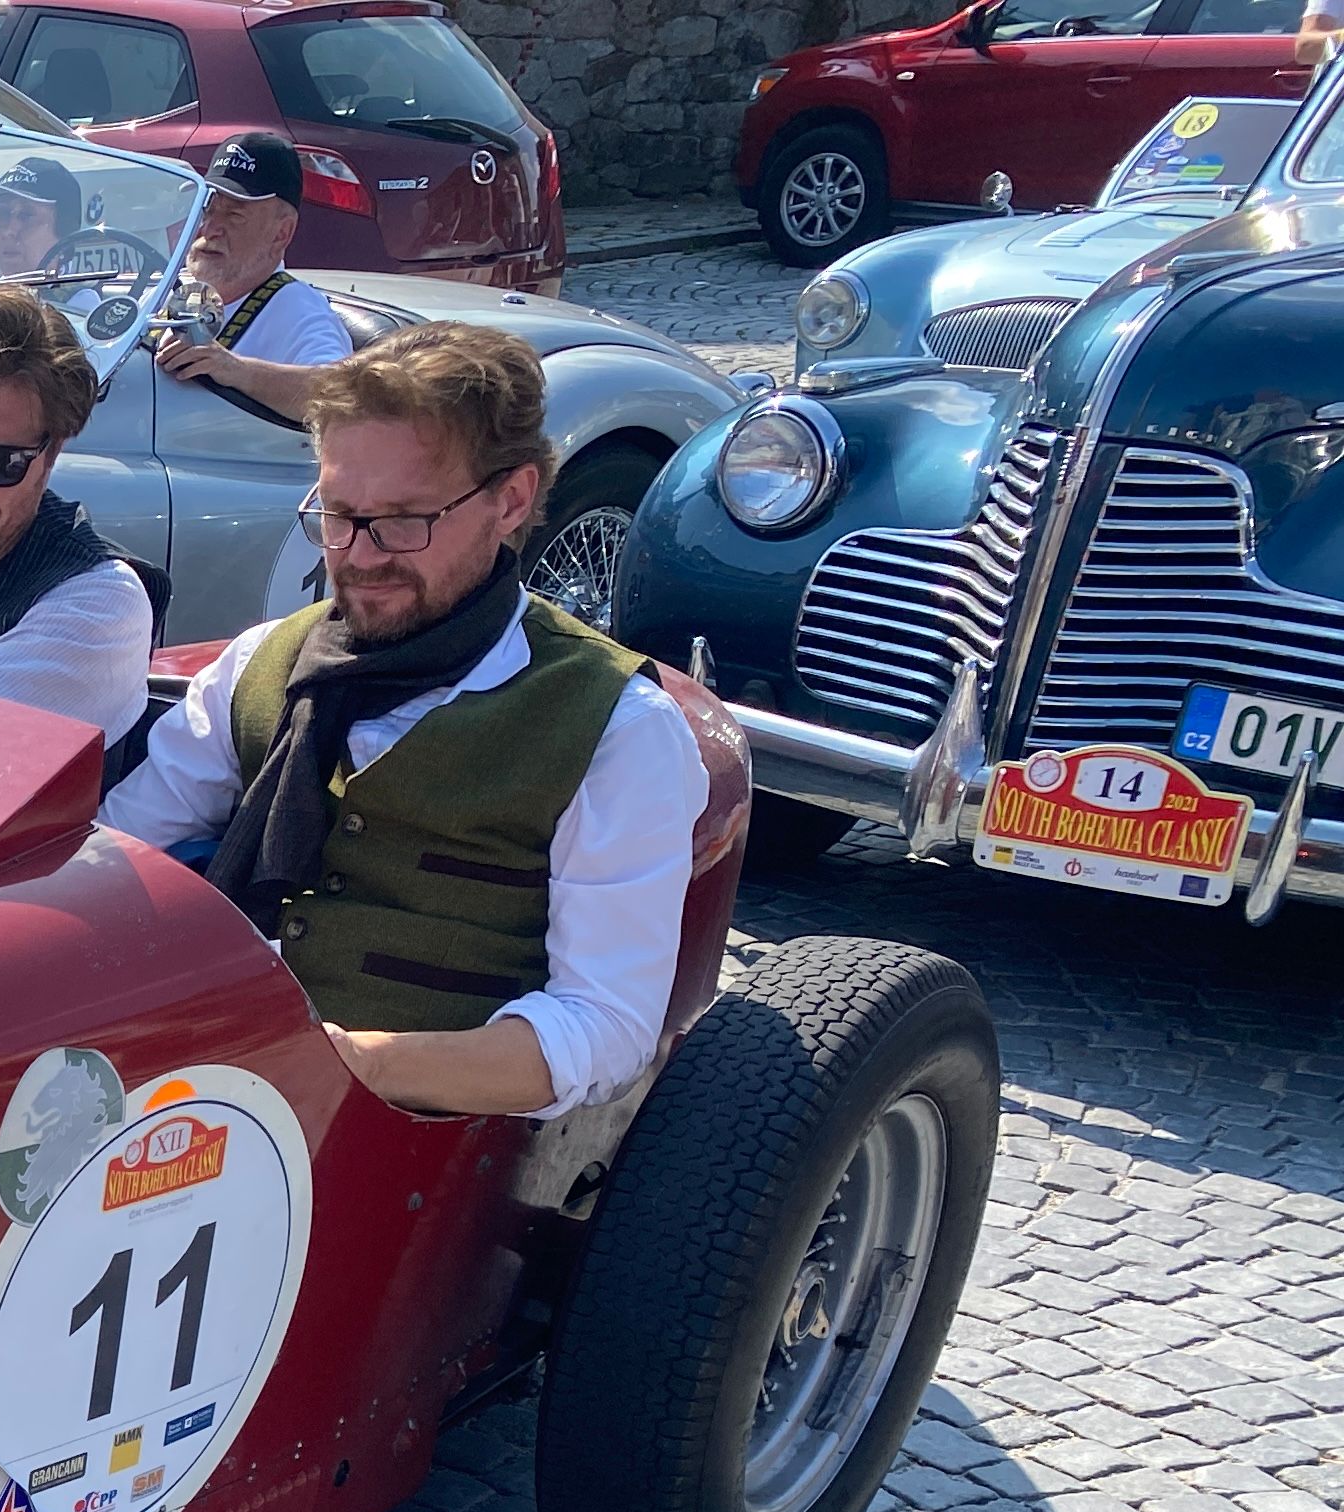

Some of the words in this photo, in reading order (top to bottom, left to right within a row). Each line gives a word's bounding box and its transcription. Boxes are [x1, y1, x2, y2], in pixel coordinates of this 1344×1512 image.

[1180, 114, 1210, 132] 18
[213, 158, 256, 172] JAGUAR
[1183, 732, 1211, 750] CZ
[1095, 767, 1144, 803] 14
[1165, 793, 1199, 813] 2021
[990, 782, 1057, 837] SOUTH
[1055, 805, 1144, 854] BOHEMIA
[1148, 816, 1236, 868] CLASSIC
[153, 1128, 185, 1158] XII.
[106, 1170, 140, 1206] SOUTH
[140, 1162, 183, 1197] BOHEMIA
[184, 1137, 224, 1183] CLASSIC
[69, 1221, 216, 1421] 11
[32, 1456, 84, 1487] GRANCANN
[134, 1469, 161, 1491] SM
